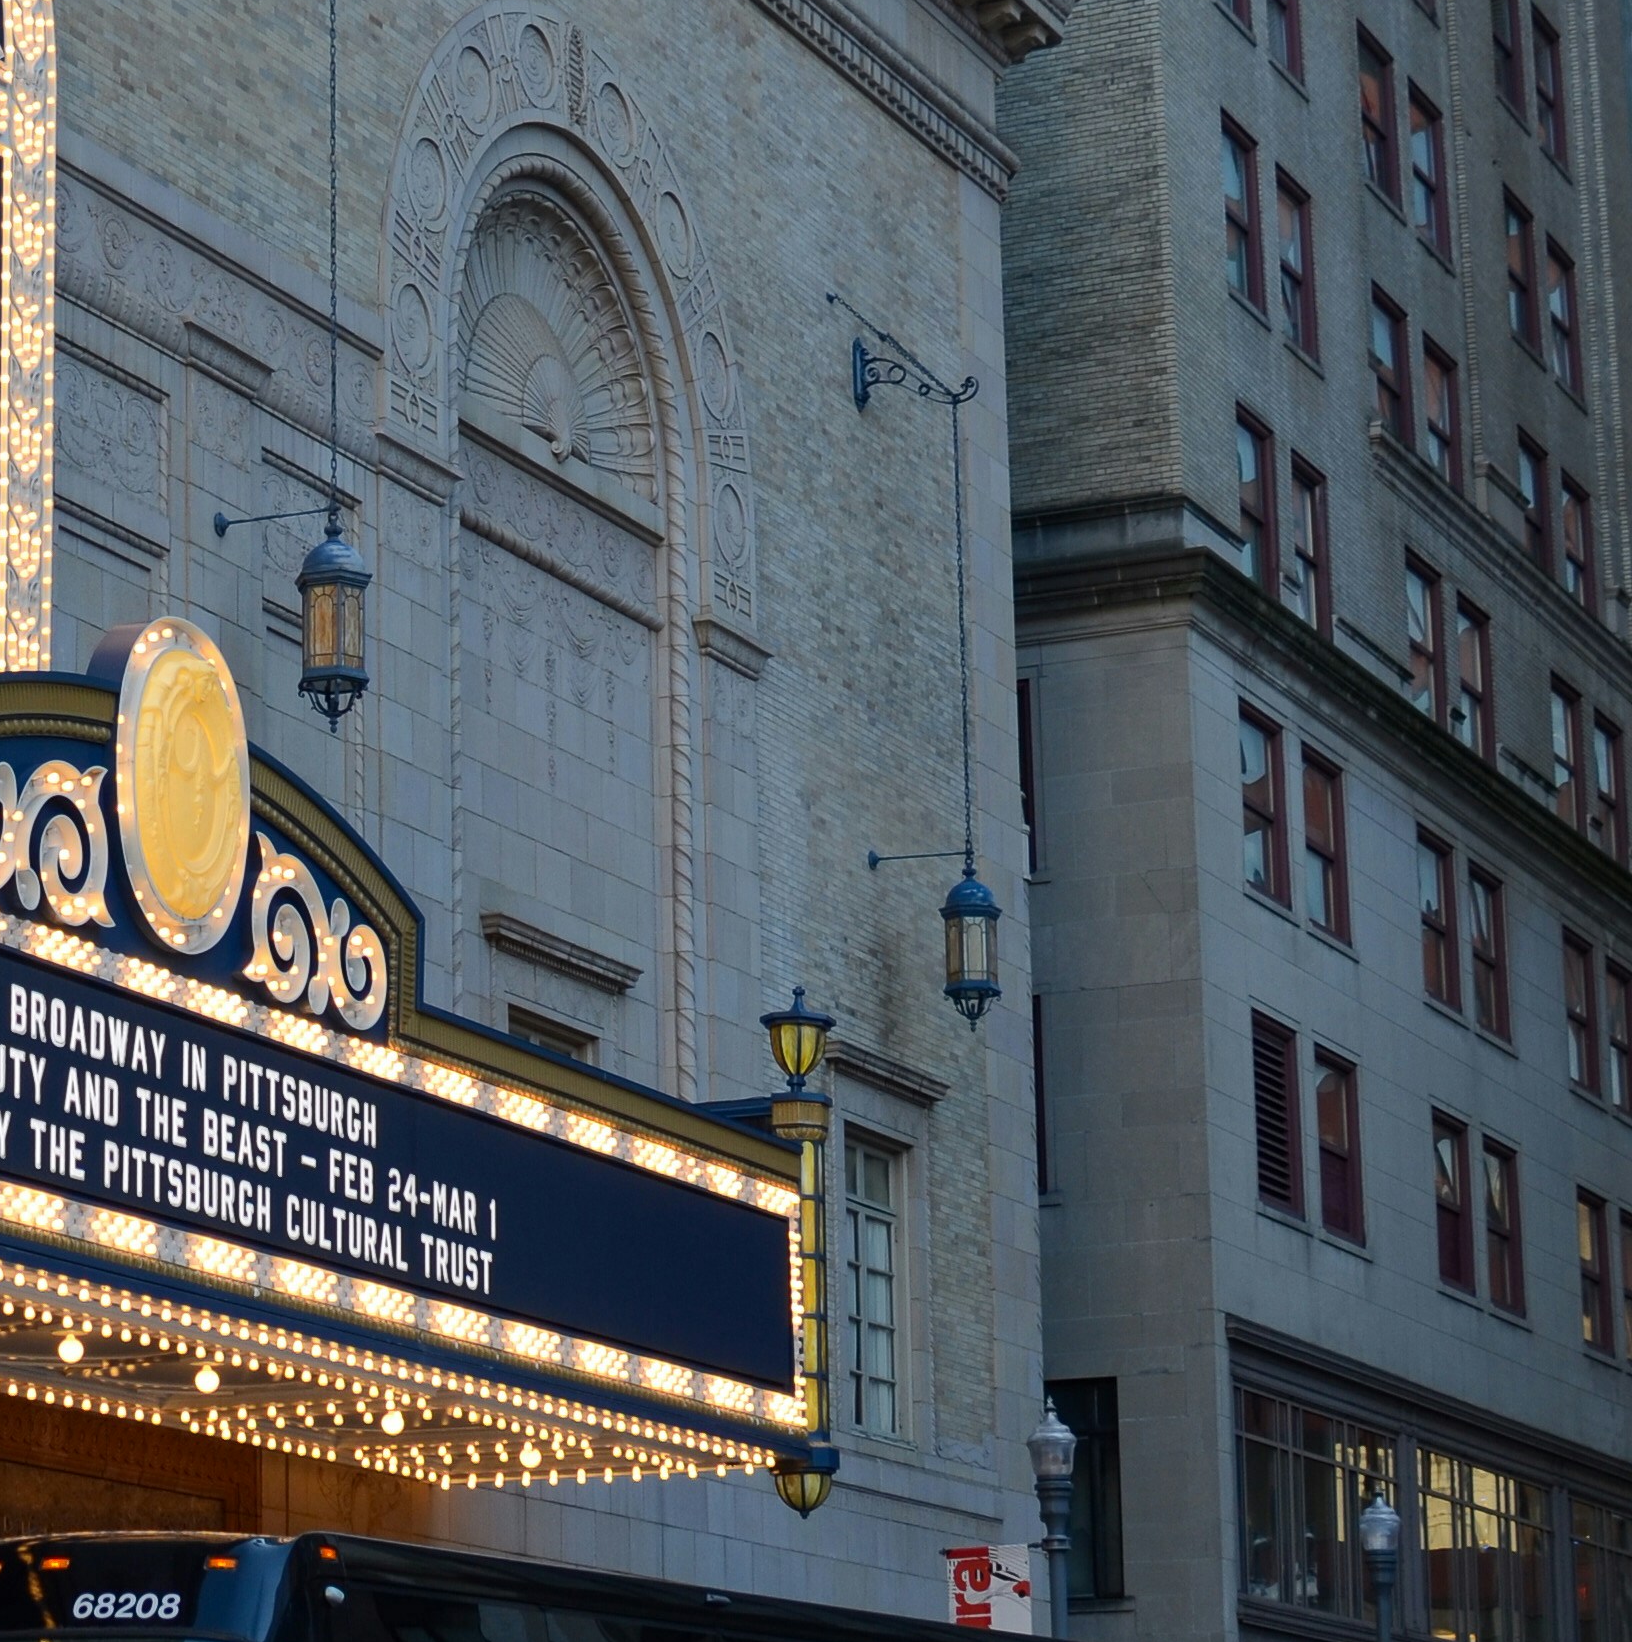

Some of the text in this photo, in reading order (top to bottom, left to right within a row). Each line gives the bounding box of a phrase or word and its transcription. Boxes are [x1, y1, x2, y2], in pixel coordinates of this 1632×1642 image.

[10, 983, 166, 1080] BROADWAY
[182, 1040, 207, 1092] IN
[223, 1054, 377, 1149] PITTSBURGH
[29, 1117, 86, 1181] THE
[103, 1139, 271, 1233] PITTSBURGH
[286, 1194, 409, 1272] CULTURAL
[420, 1232, 493, 1295] TRUST
[63, 1066, 119, 1127] AND
[136, 1086, 188, 1148] THE
[203, 1107, 287, 1178] BEAST
[329, 1147, 374, 1204] FEB
[388, 1167, 478, 1236] 24-MAR
[489, 1198, 497, 1241] 1
[74, 1593, 181, 1619] 68208
